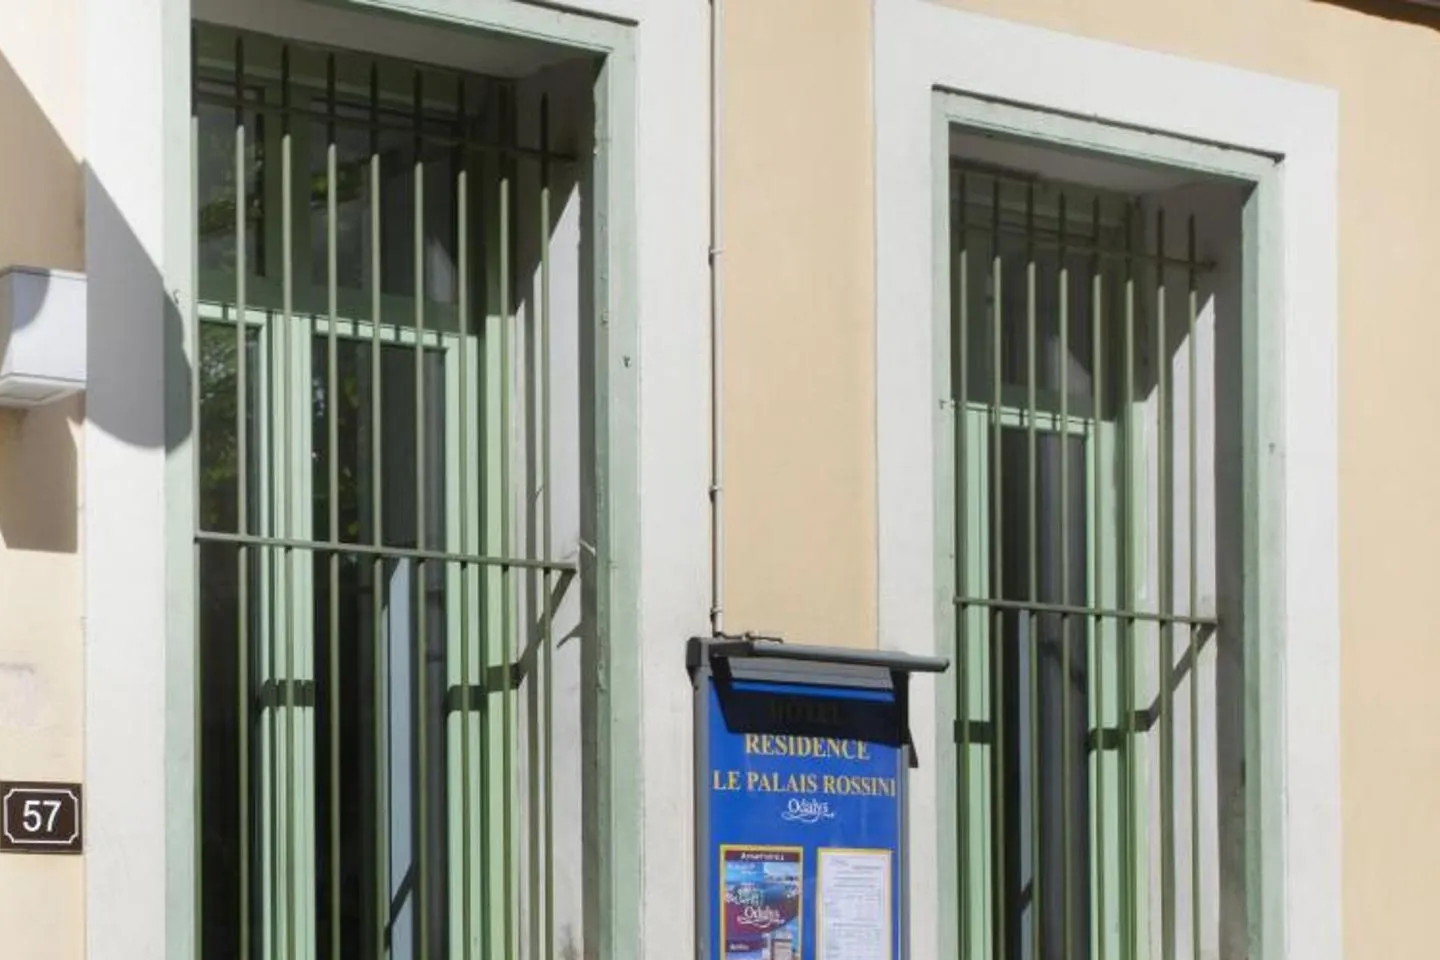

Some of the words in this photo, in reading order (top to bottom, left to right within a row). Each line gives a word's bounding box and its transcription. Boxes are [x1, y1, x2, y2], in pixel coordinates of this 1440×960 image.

[744, 733, 871, 760] RESIDENCE
[713, 769, 741, 791] LE
[746, 772, 817, 793] PALAIS
[823, 775, 896, 796] ROSSINI
[23, 800, 62, 832] 57
[787, 798, 830, 817] Odalys
